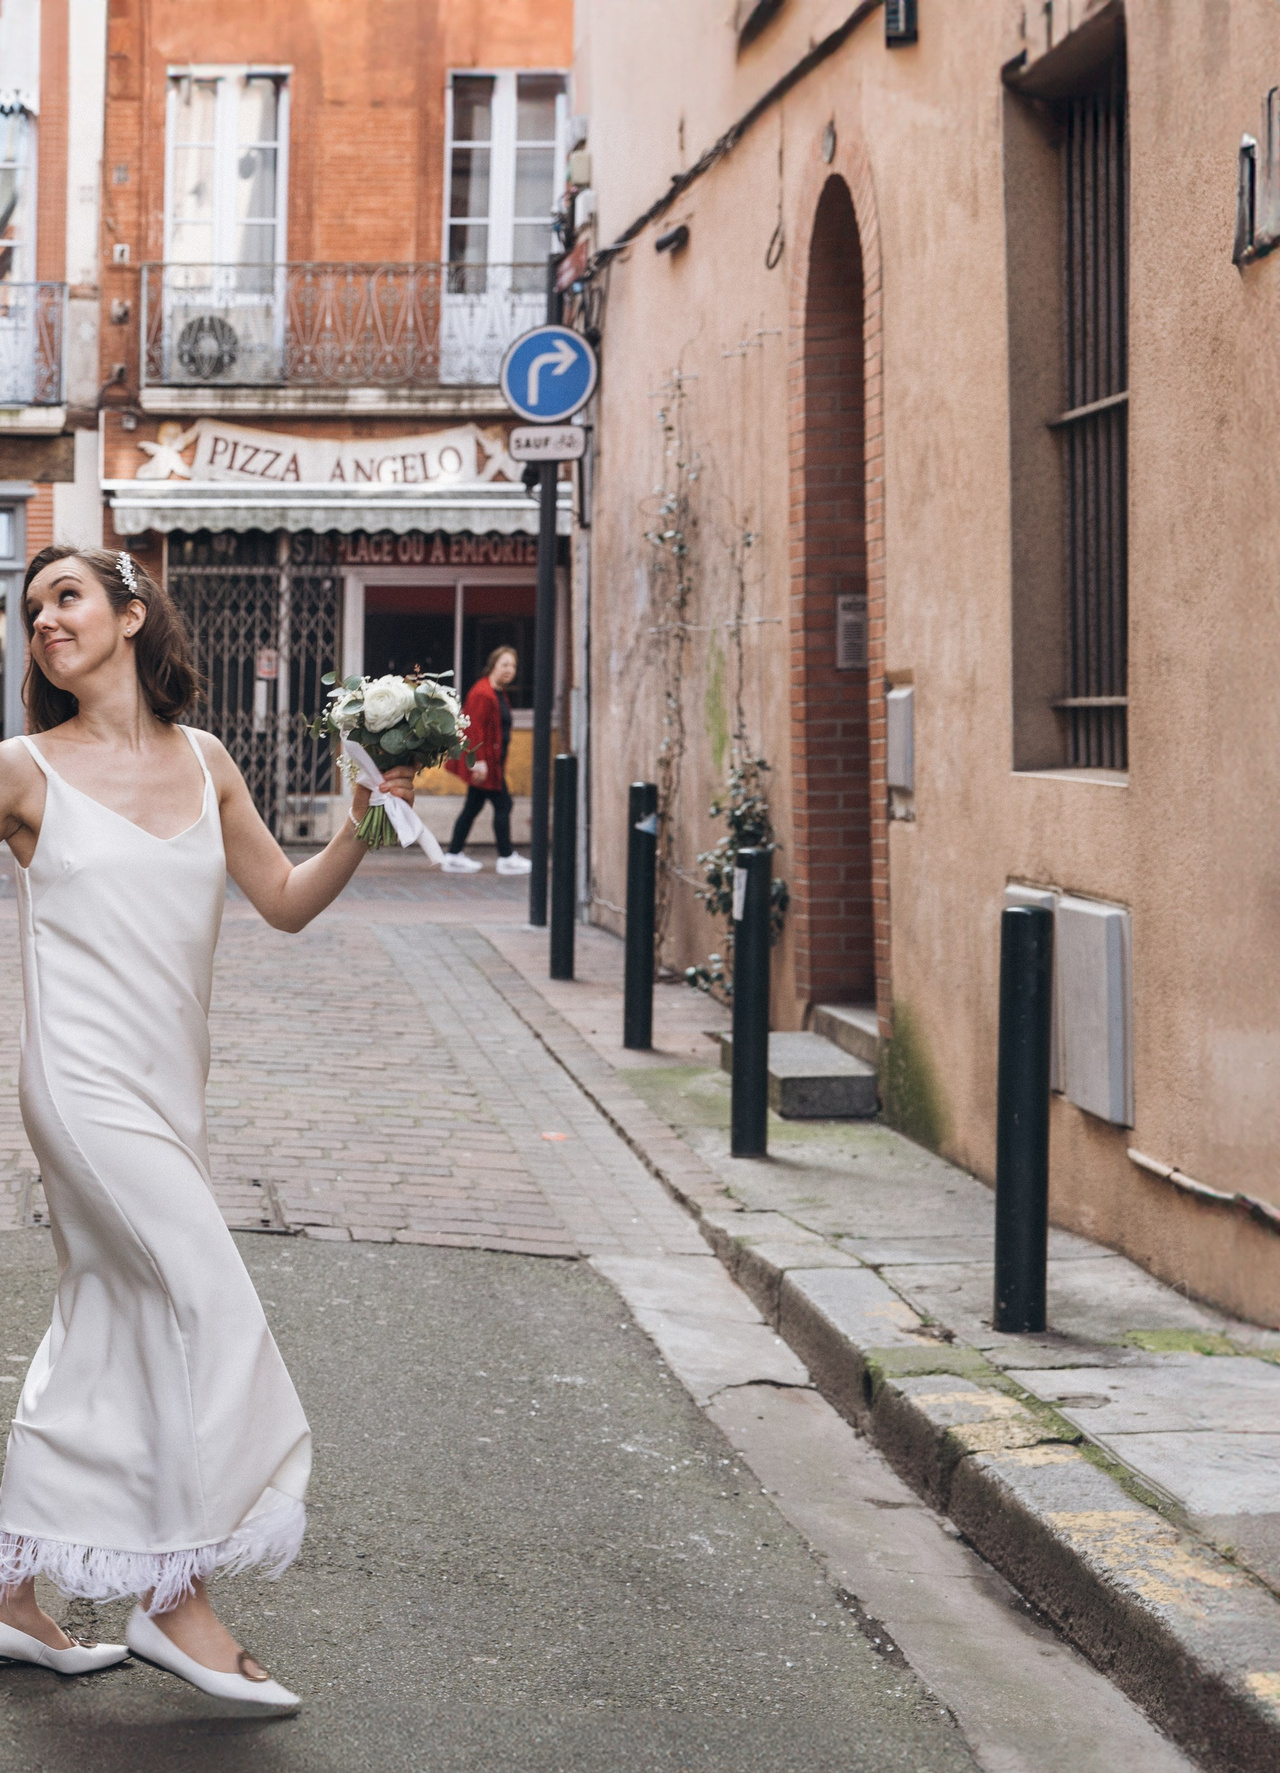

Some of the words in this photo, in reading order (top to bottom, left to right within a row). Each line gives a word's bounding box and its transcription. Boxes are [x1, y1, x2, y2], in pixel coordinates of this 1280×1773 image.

[514, 436, 550, 450] SAUF
[208, 437, 301, 482] PIZZA
[329, 446, 463, 483] ANGELO
[397, 534, 425, 563] OU
[450, 534, 539, 564] EMPORTE
